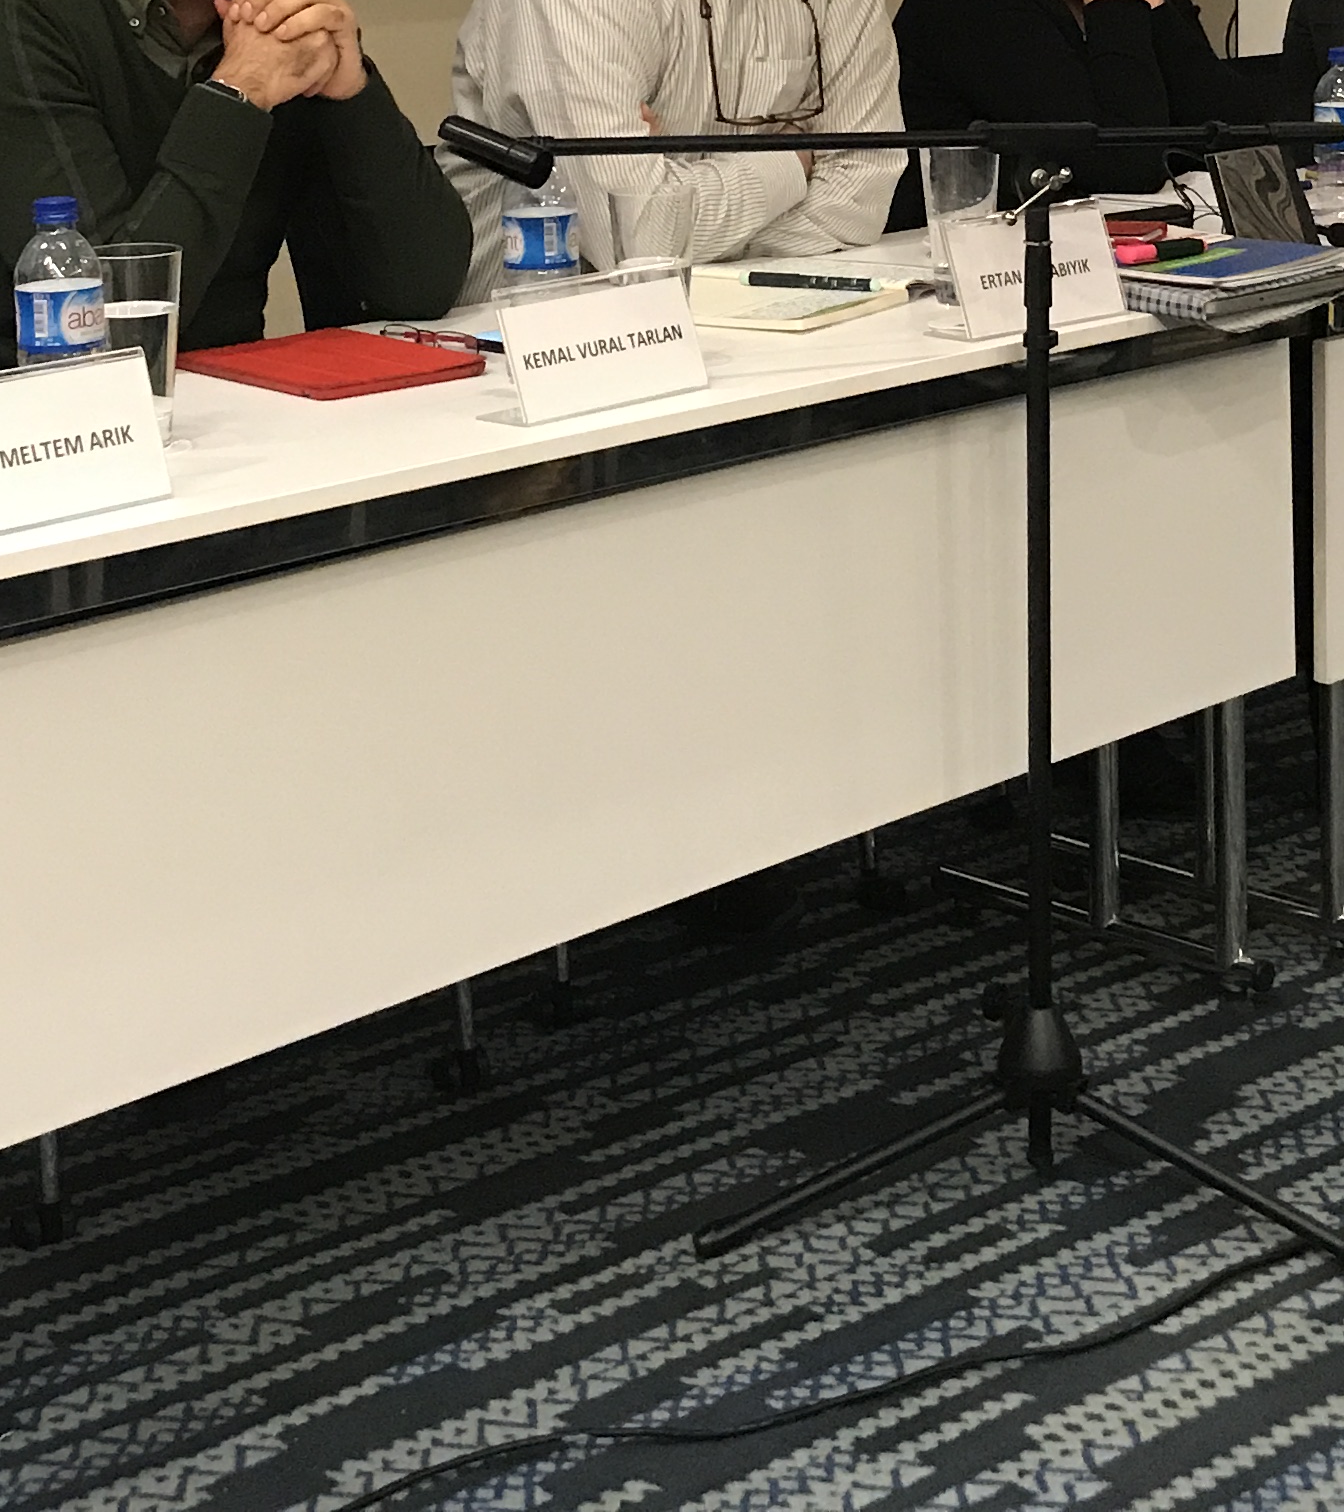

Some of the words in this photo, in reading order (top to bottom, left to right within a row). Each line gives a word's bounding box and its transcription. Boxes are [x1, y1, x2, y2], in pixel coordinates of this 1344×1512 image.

[979, 269, 1023, 290] ERTAN
[1051, 258, 1091, 279] ABIYIK
[522, 346, 576, 371] KEMAL
[576, 336, 627, 360] VURAL
[627, 324, 684, 350] TARLAN
[0, 434, 84, 470] MELTEM
[89, 424, 135, 452] ARIK
